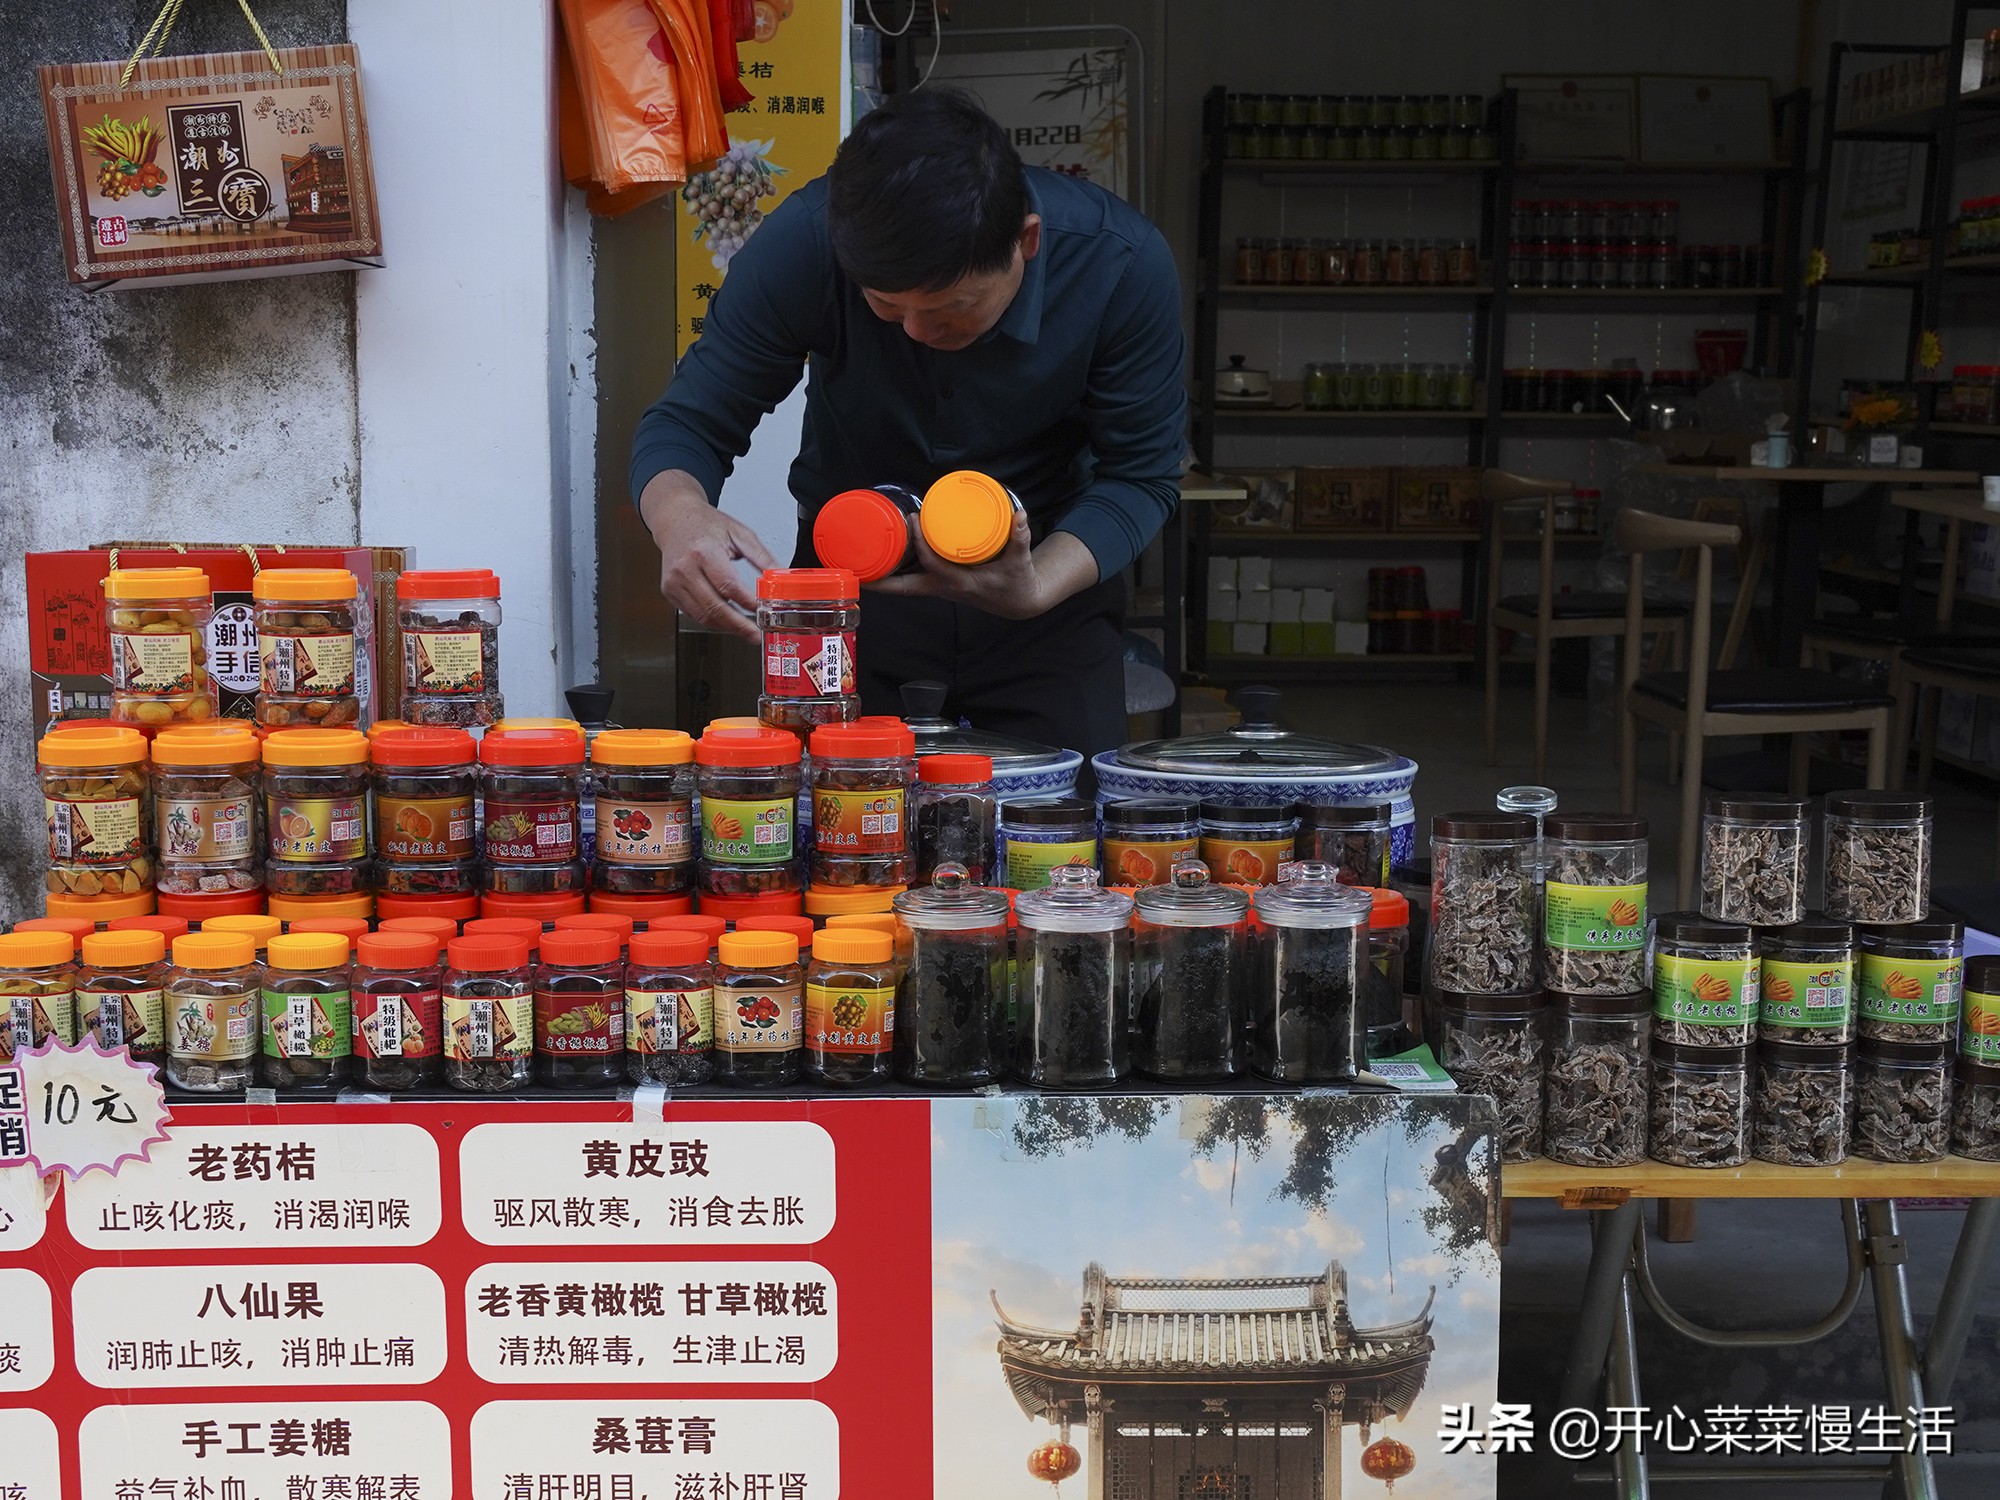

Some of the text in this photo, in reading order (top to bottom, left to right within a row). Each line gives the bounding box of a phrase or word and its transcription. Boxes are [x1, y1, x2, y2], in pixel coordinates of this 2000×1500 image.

[827, 643, 838, 688] 特级枇杷
[168, 840, 198, 855] 姜糖
[11, 998, 31, 1007] 正宗
[100, 995, 121, 1004] 正宗
[471, 1002, 491, 1011] 正宗
[656, 994, 677, 1004] 正宗
[178, 1036, 211, 1053] 姜糖
[383, 1004, 397, 1051] 特级枇杷
[475, 1011, 489, 1055] 潮州特产
[660, 1004, 674, 1050] 潮州特产
[44, 1081, 138, 1125] 10元
[188, 1142, 316, 1182] 老药桔
[582, 1139, 710, 1179] 黄皮豉
[197, 1282, 324, 1320] 八仙果
[478, 1282, 828, 1318] 老香黄橄榄 甘草橄榄
[182, 1418, 352, 1458] 手工姜糖
[592, 1416, 716, 1455] 桑葚膏
